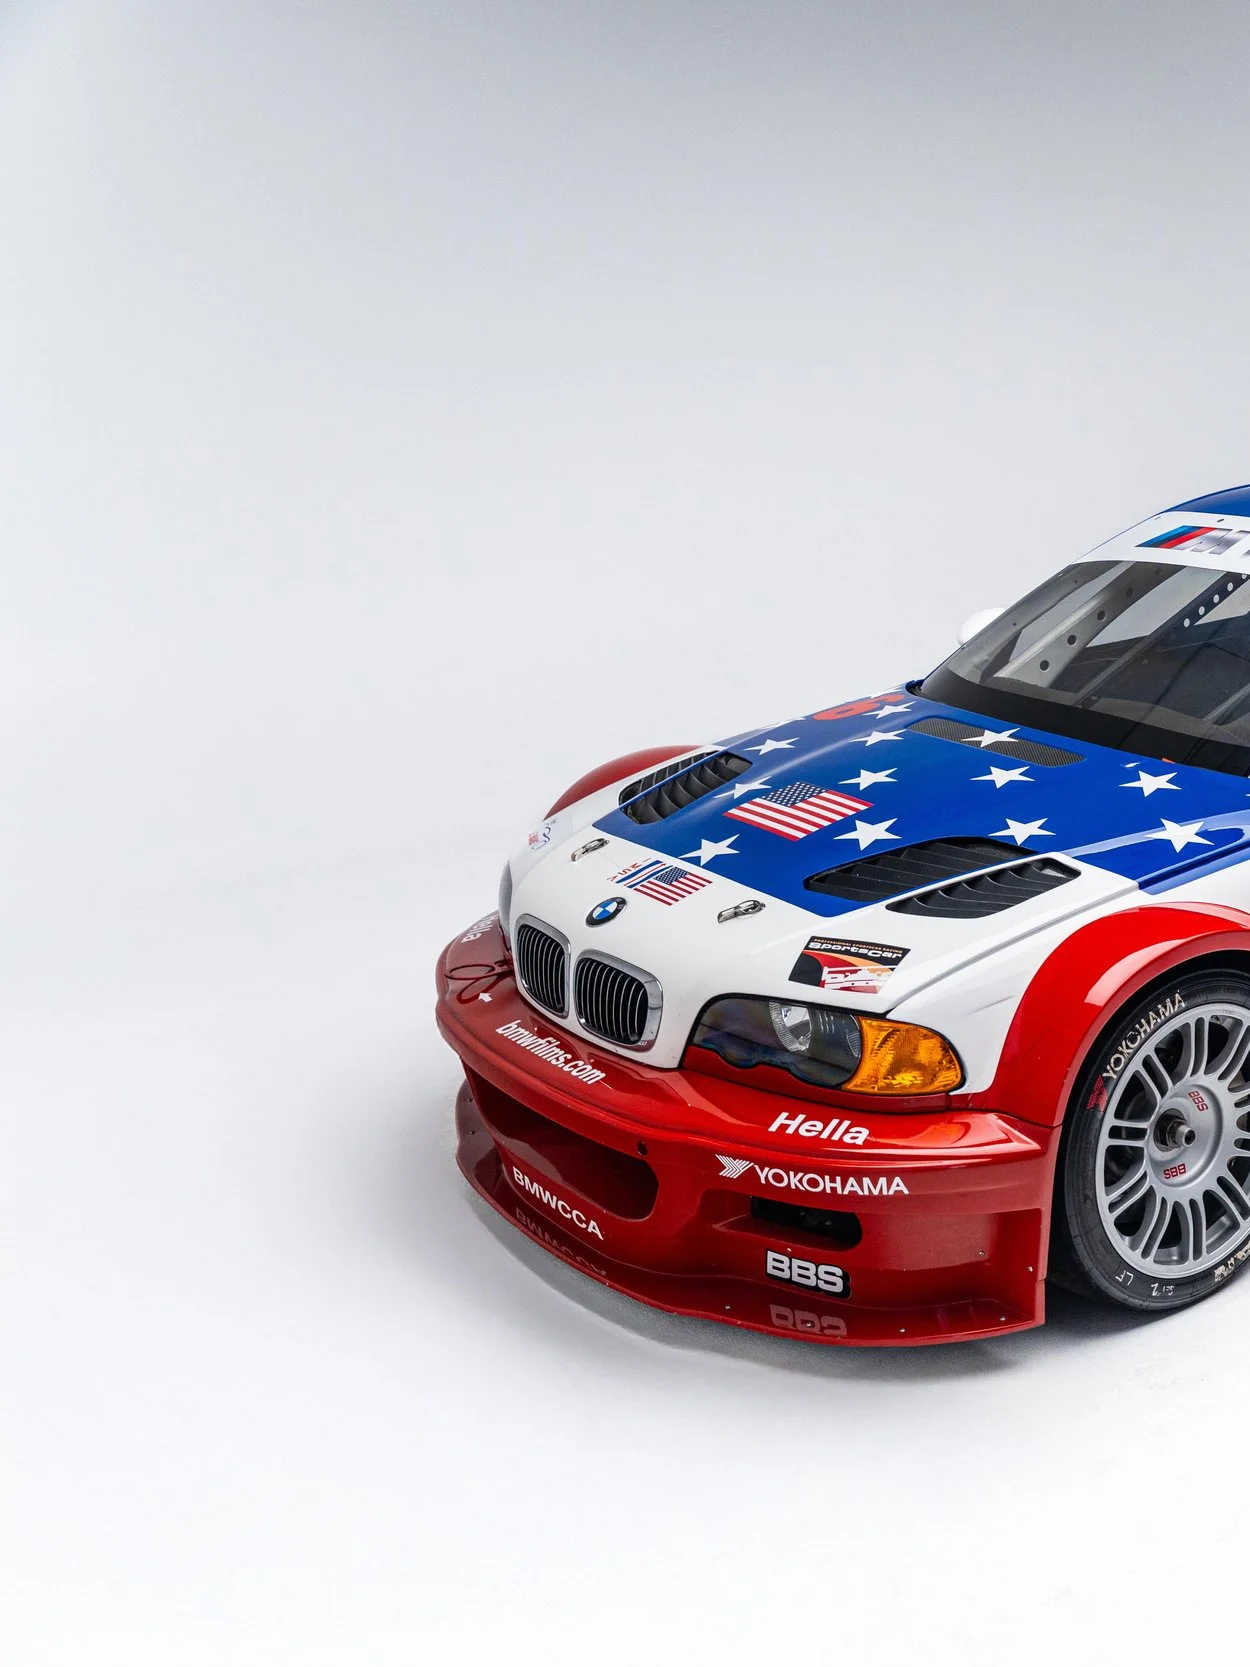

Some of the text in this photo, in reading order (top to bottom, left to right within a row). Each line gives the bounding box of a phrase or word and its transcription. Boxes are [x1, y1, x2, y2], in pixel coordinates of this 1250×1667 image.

[808, 941, 903, 959] SportsCar
[1102, 988, 1187, 1081] YOKOHAMA
[496, 1020, 607, 1085] bmwfilms.com
[1187, 1089, 1208, 1113] BBS
[768, 1111, 870, 1146] Hella
[753, 1164, 910, 1196] YOKOHAMA
[1163, 1163, 1187, 1181] BBS
[512, 1166, 604, 1241] BMWCCA
[767, 1250, 844, 1294] BBS
